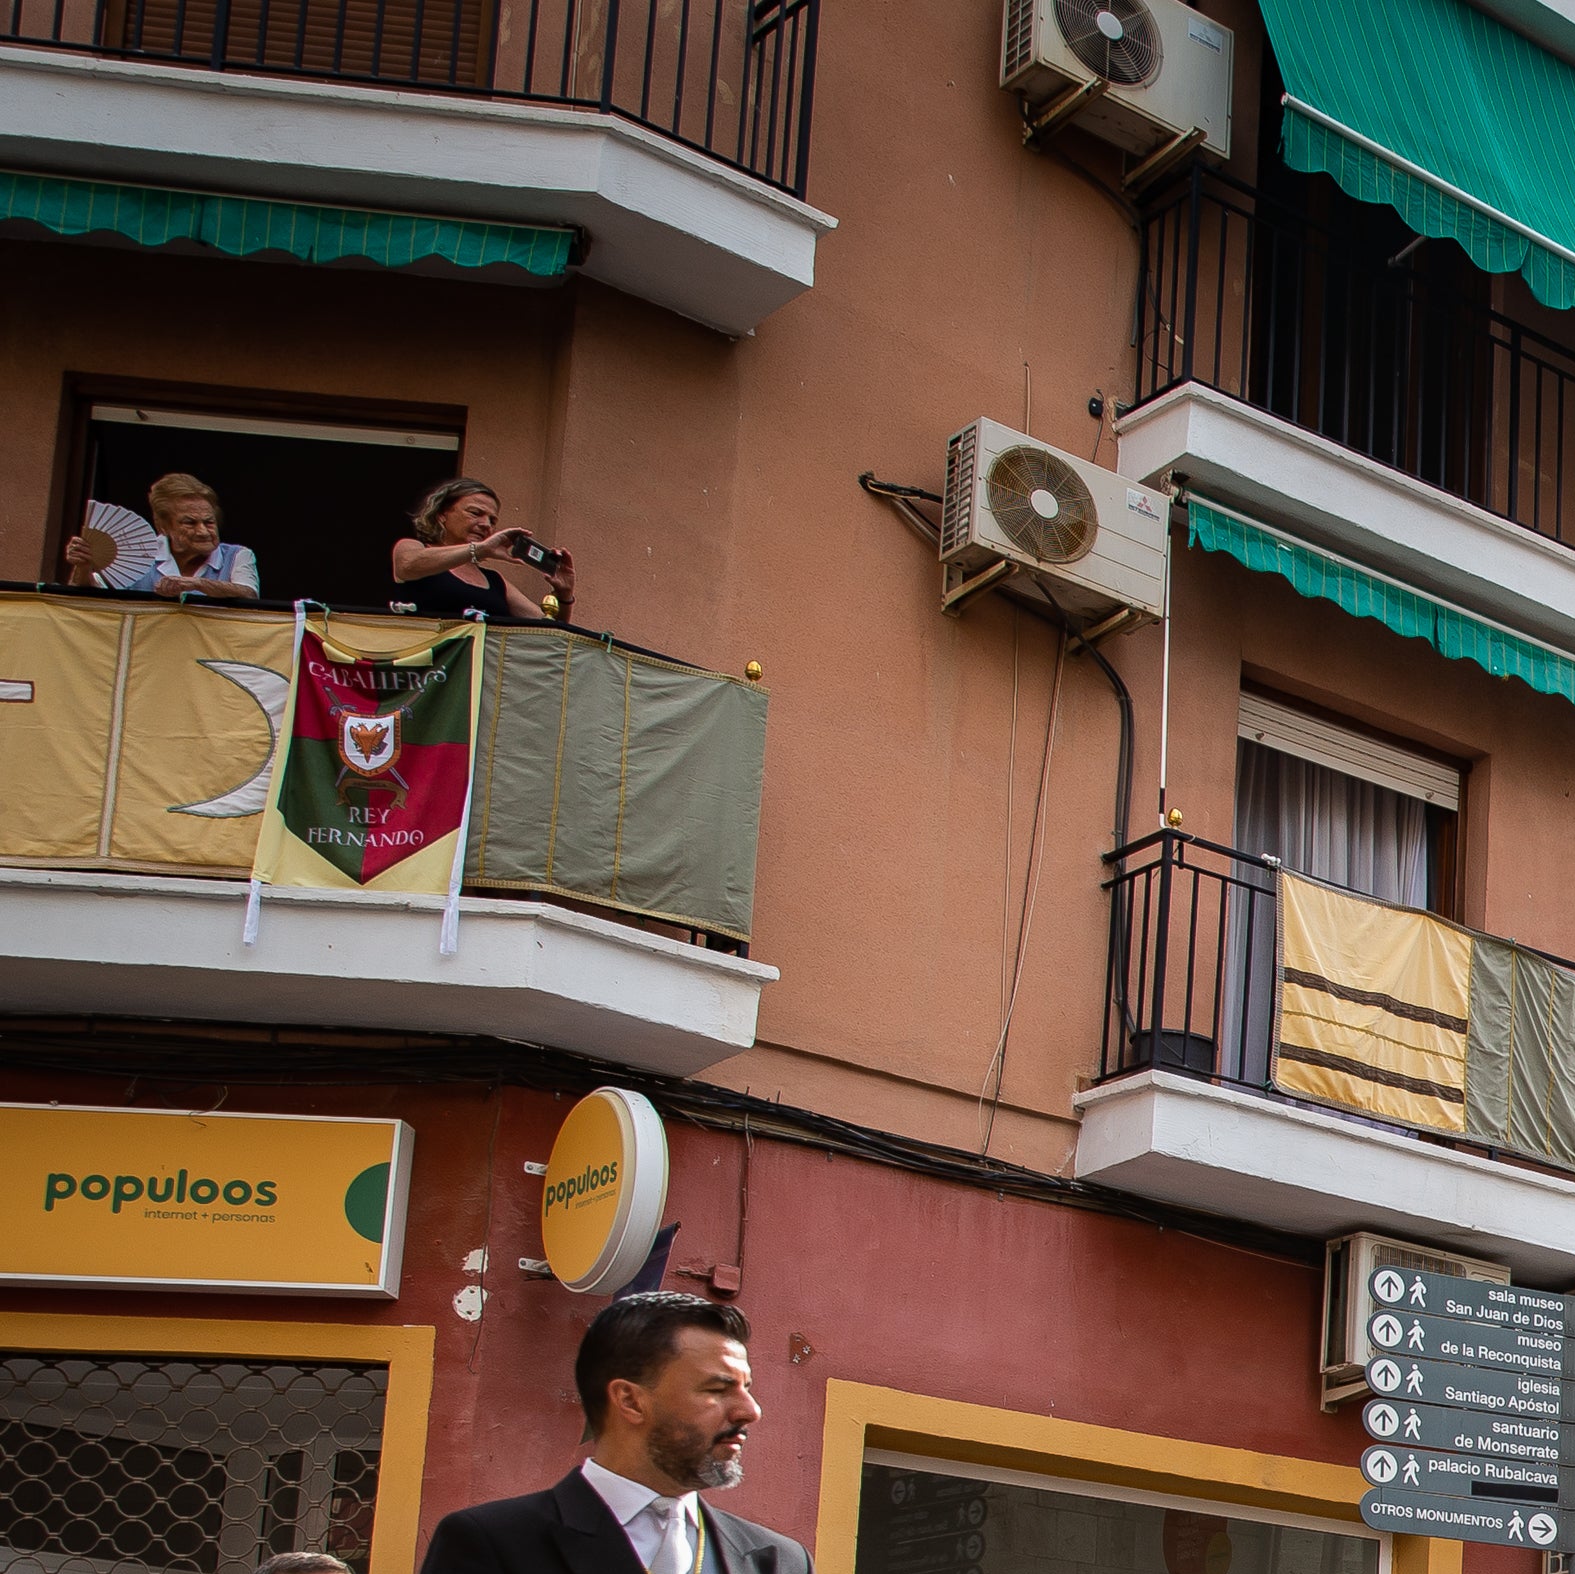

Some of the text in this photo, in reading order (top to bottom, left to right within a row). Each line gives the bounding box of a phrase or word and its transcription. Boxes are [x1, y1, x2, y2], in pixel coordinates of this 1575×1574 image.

[349, 806, 392, 825] REY
[307, 827, 424, 849] FERNANDO
[44, 1168, 278, 1215] populoos
[545, 1161, 618, 1217] populoos
[144, 1208, 198, 1221] internet
[211, 1211, 276, 1224] personas
[1488, 1290, 1564, 1312] sala museo
[1446, 1299, 1564, 1331] San Juan de Dios
[1440, 1341, 1562, 1371] de la Reconquista
[1517, 1335, 1562, 1352] museo
[1517, 1377, 1561, 1396] iglesia
[1445, 1386, 1559, 1415] Santiago Apóstol
[1492, 1421, 1559, 1441] santuario
[1454, 1434, 1559, 1460] de Monserrate
[1428, 1458, 1558, 1485] palacio Rubalcava
[1370, 1502, 1504, 1529] OTROS MONUMENTOS
